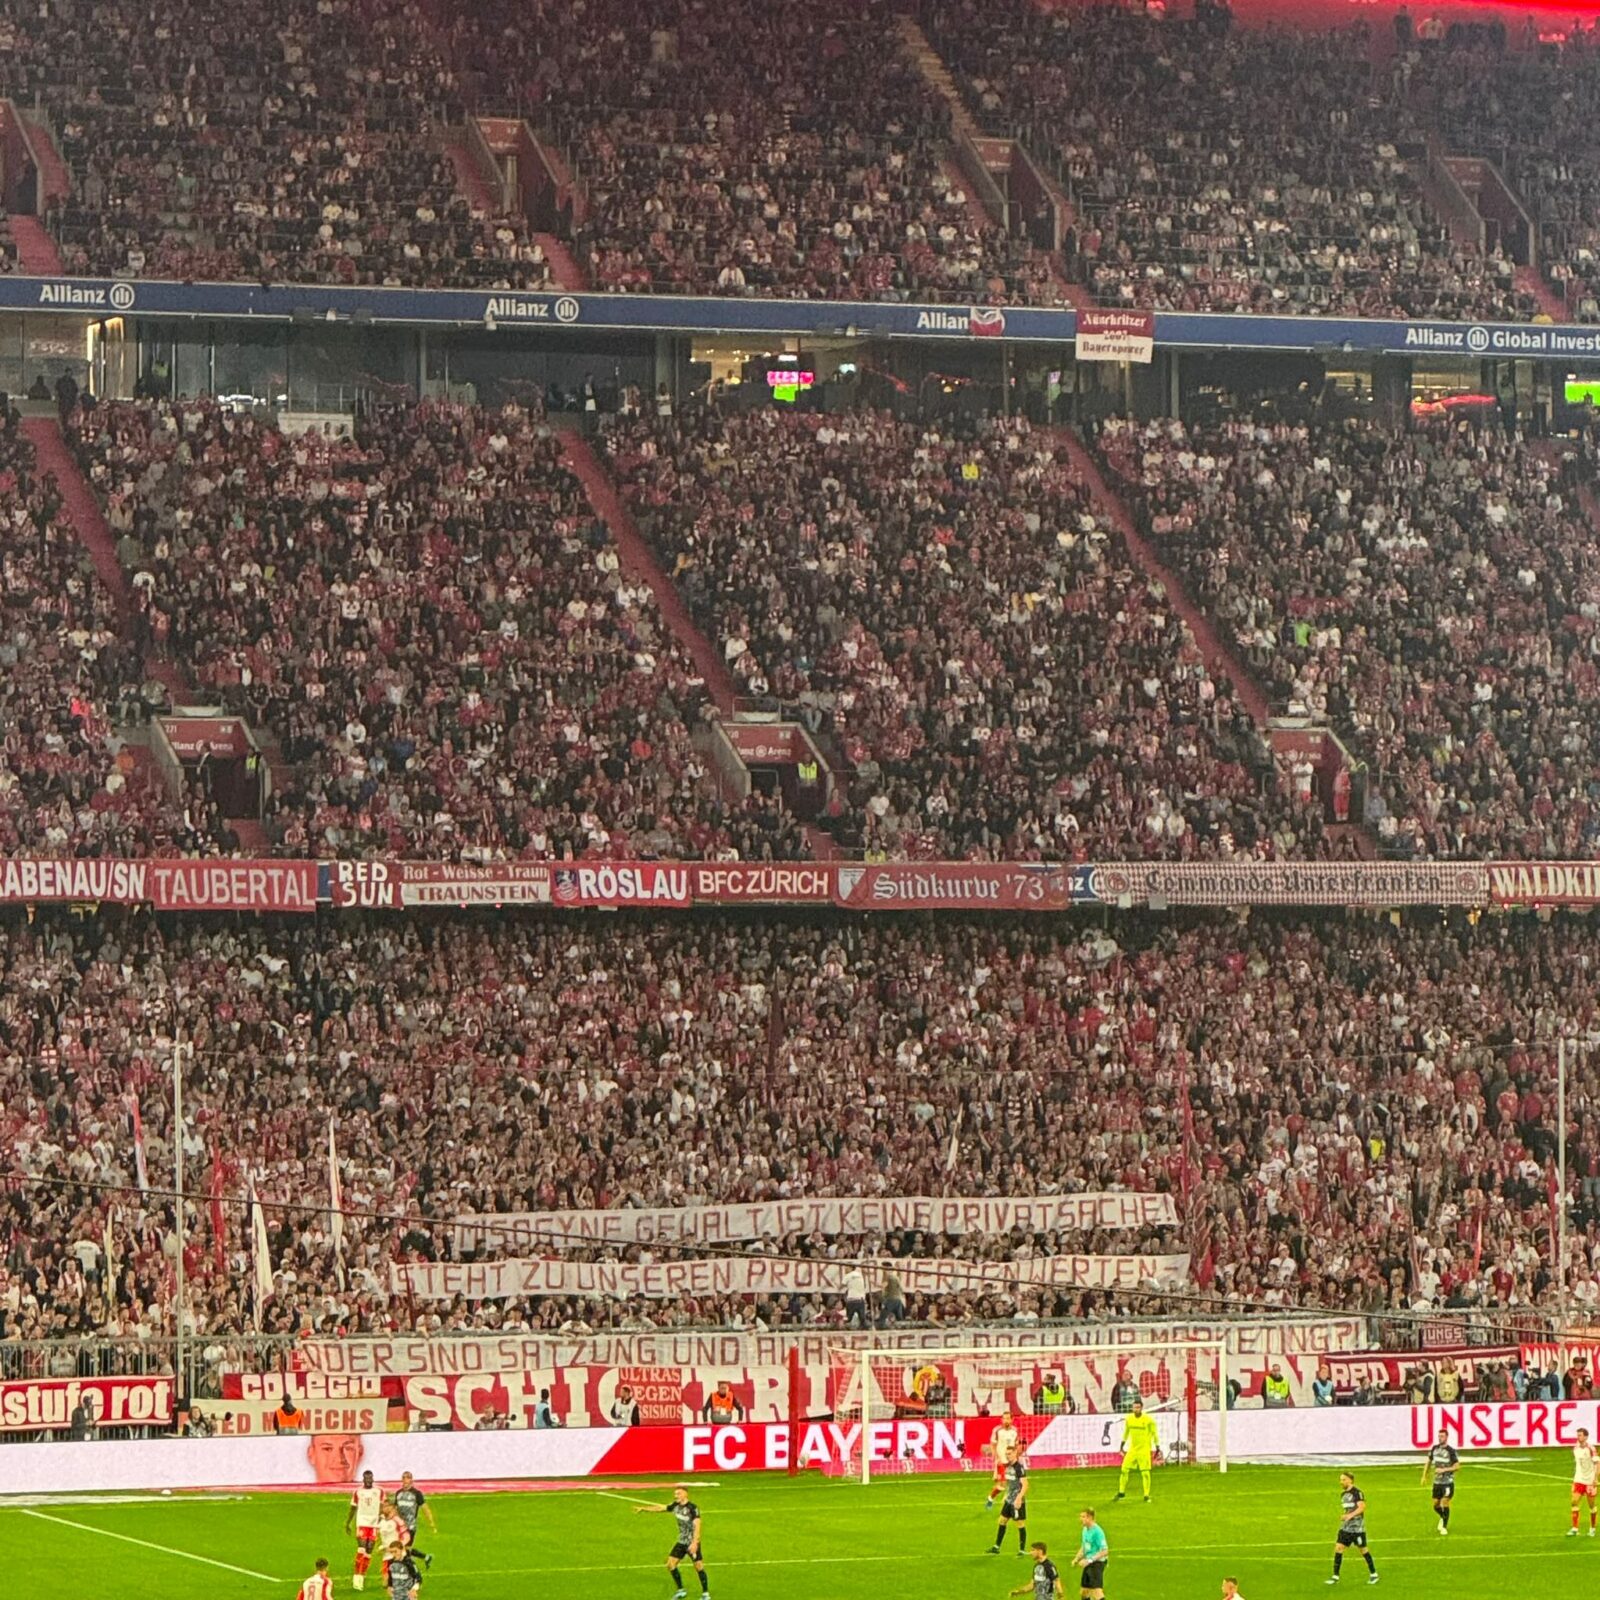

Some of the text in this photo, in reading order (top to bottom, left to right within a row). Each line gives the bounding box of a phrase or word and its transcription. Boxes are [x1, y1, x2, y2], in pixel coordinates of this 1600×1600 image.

[39, 285, 105, 304] Allianz
[486, 298, 549, 317] Allianz
[917, 311, 969, 330] Allian
[1405, 328, 1463, 346] Allianz
[1493, 331, 1546, 349] Global
[0, 860, 146, 899] ABENAU/SN
[338, 861, 388, 882] RED
[404, 865, 428, 880] Rot
[442, 865, 493, 880] Weisse
[579, 866, 687, 901] RÖSLAU
[699, 867, 828, 894] BFC ZÜRICH
[1146, 870, 1273, 893] Commando
[155, 868, 316, 906] TAUBERTAL
[341, 882, 393, 906] SUN
[416, 885, 539, 901] TRAUNSTEIN
[873, 872, 1000, 900] Südkurve
[777, 1203, 826, 1232] IST
[838, 1201, 930, 1230] KEINE
[397, 1264, 507, 1294] STEHT
[522, 1262, 565, 1291] ZU
[577, 1261, 731, 1294] UNSEREN
[498, 1336, 655, 1370] SATZUNG
[673, 1335, 741, 1367] UND
[619, 1367, 681, 1382] ULTRAS
[112, 1380, 171, 1420] rot
[1411, 1403, 1577, 1448] UNSERE
[684, 1421, 965, 1471] FC BAYERN
